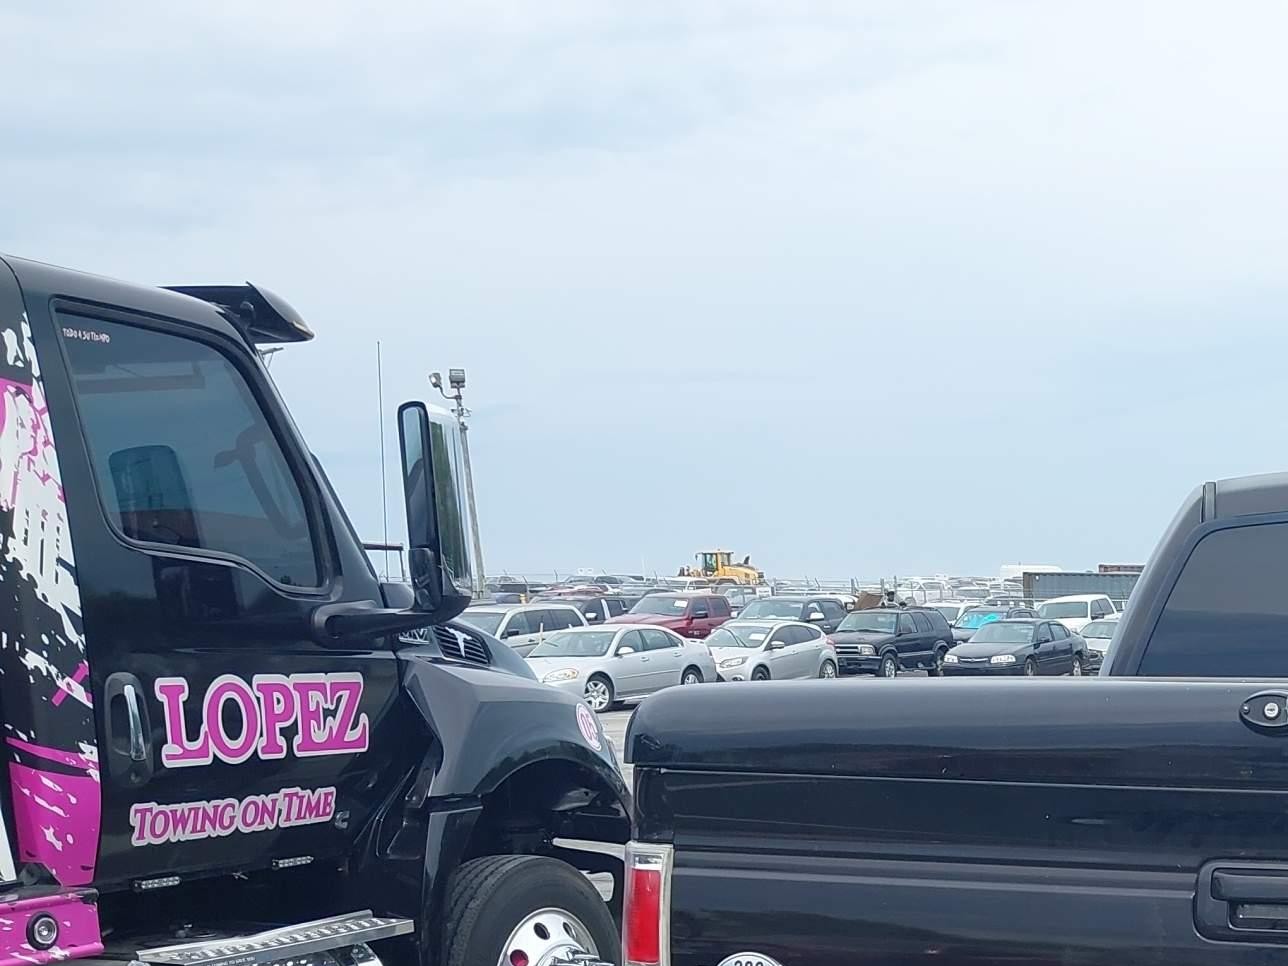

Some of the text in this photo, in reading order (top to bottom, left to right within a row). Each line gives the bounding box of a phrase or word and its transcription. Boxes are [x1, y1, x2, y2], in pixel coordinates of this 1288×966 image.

[155, 672, 369, 768] LOPEZ
[131, 787, 336, 846] TOWING ON TIME
